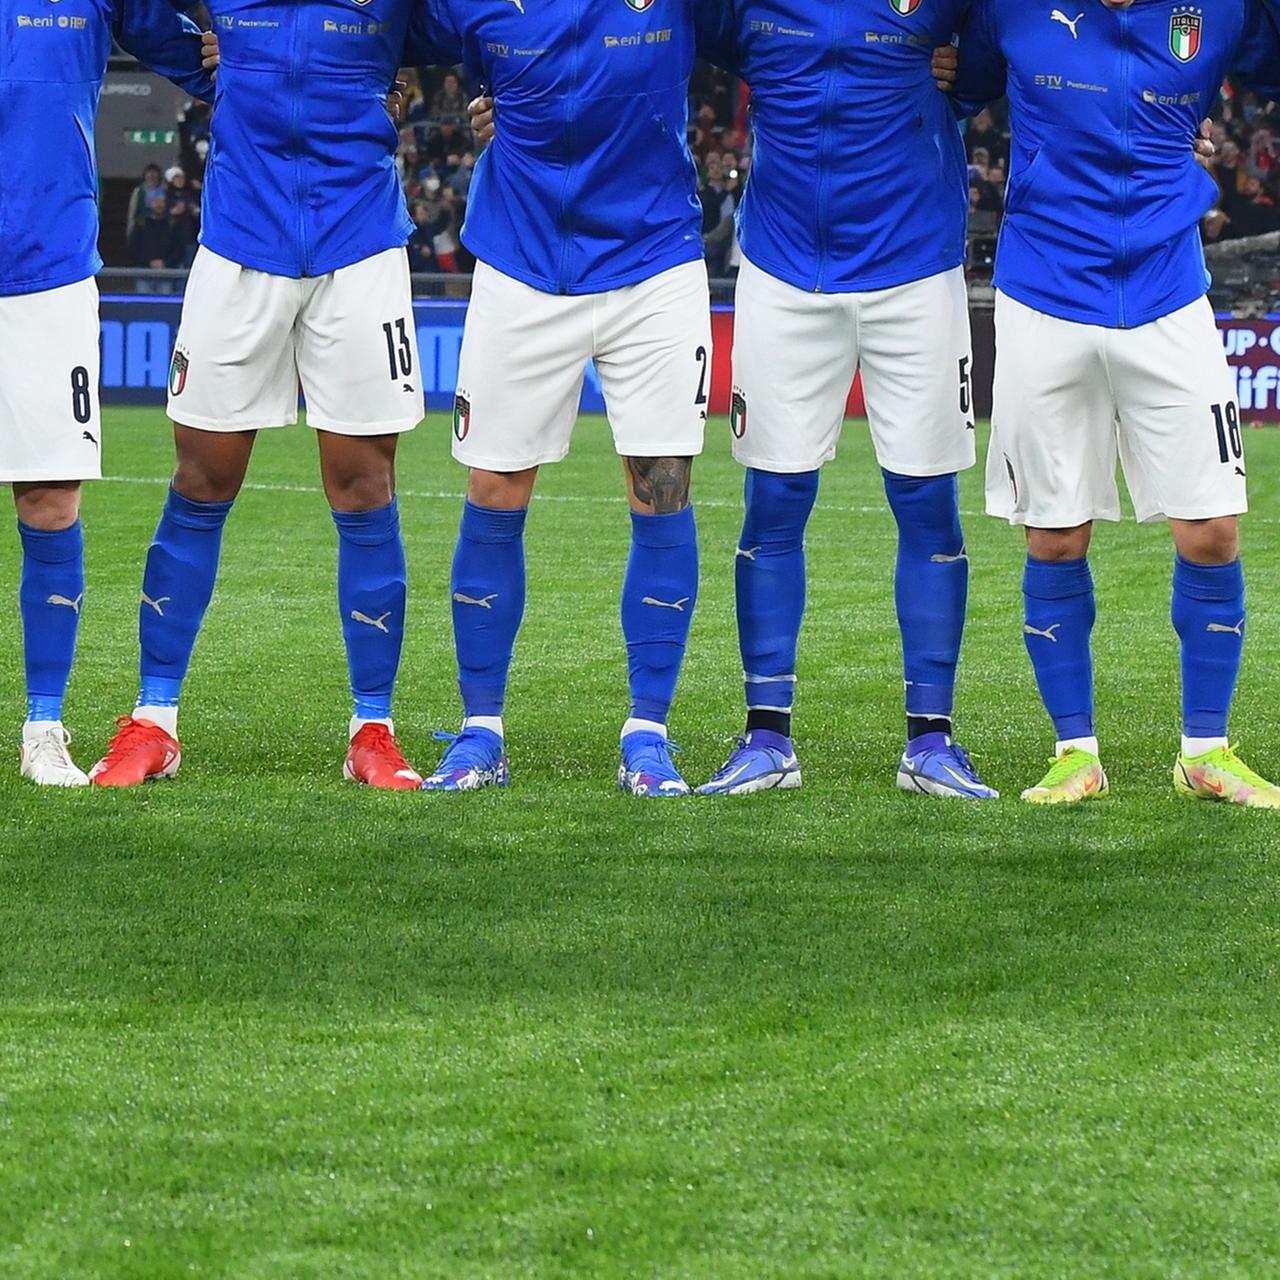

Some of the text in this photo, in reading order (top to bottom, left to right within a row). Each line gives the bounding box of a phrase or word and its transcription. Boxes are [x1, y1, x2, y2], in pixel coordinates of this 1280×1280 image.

[31, 14, 53, 27] eni
[1172, 18, 1200, 27] ITALIA
[339, 21, 362, 34] eni
[619, 32, 641, 46] eni
[881, 32, 904, 45] eni
[1046, 75, 1062, 86] TV
[1158, 92, 1178, 105] eni
[382, 317, 412, 381] 13
[694, 345, 707, 405] 2
[958, 355, 970, 414] 5
[70, 366, 91, 424] 8
[1210, 400, 1242, 464] 18
